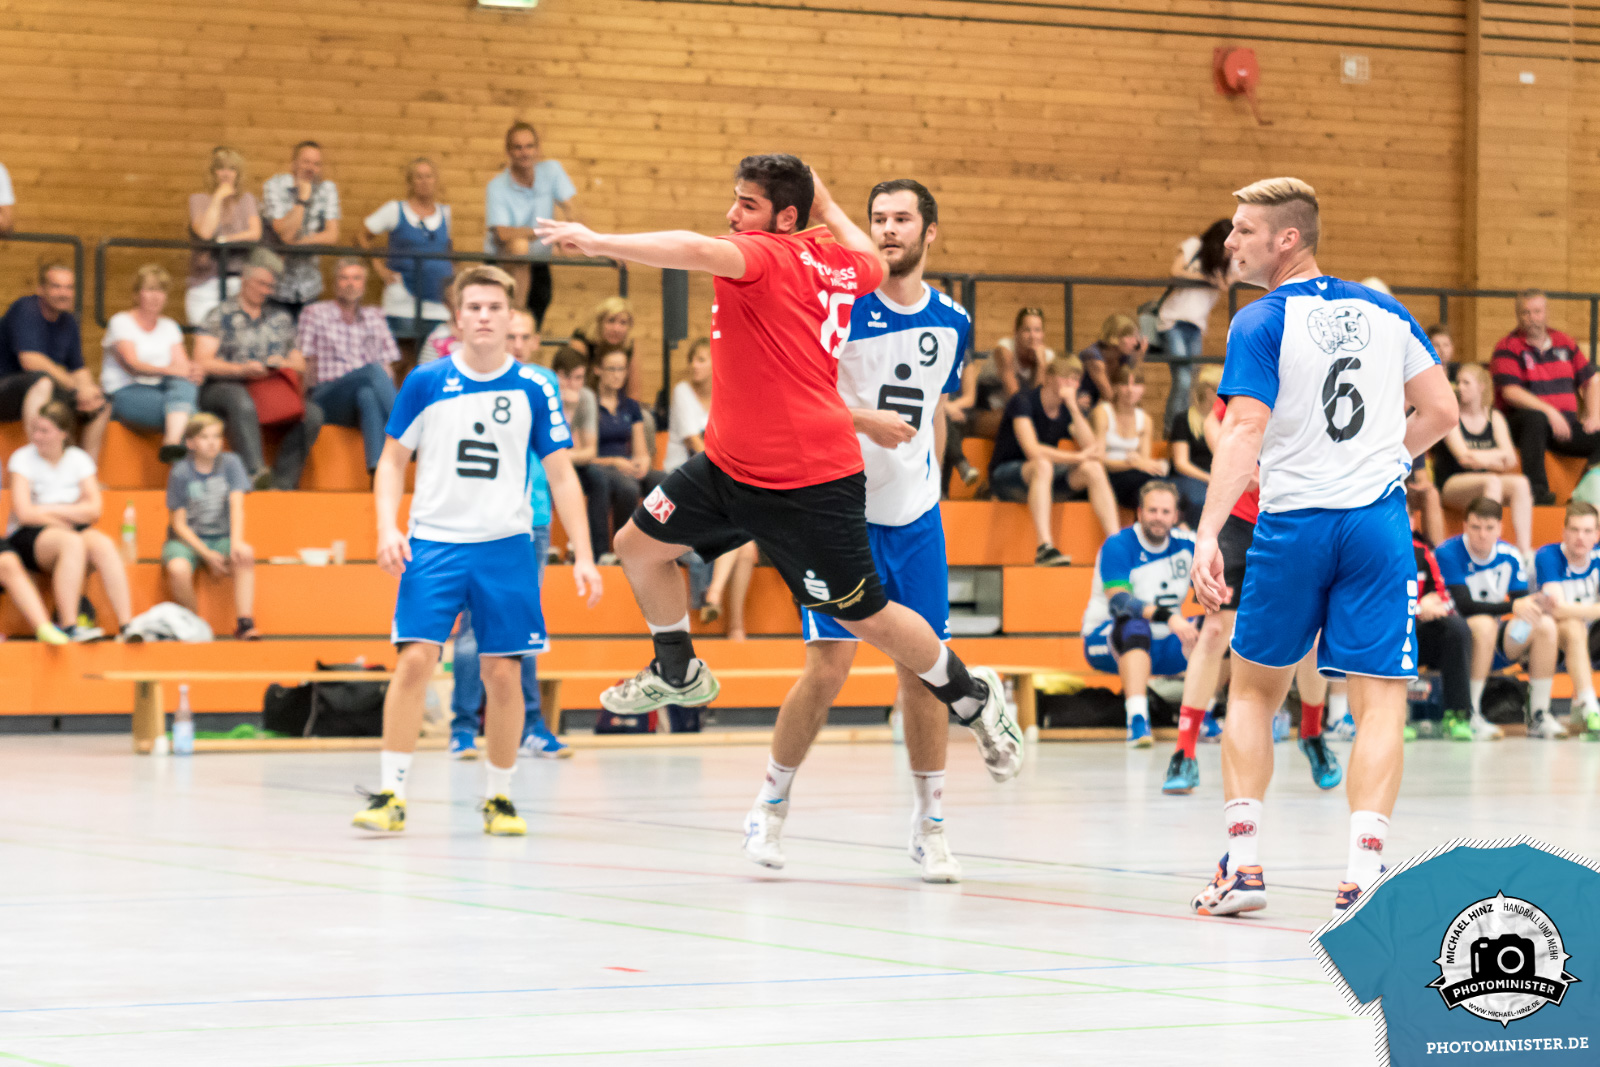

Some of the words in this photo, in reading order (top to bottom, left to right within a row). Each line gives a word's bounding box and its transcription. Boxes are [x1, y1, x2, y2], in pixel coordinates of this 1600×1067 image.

[918, 331, 938, 367] 9
[492, 396, 511, 424] 8
[1321, 356, 1365, 443] 6
